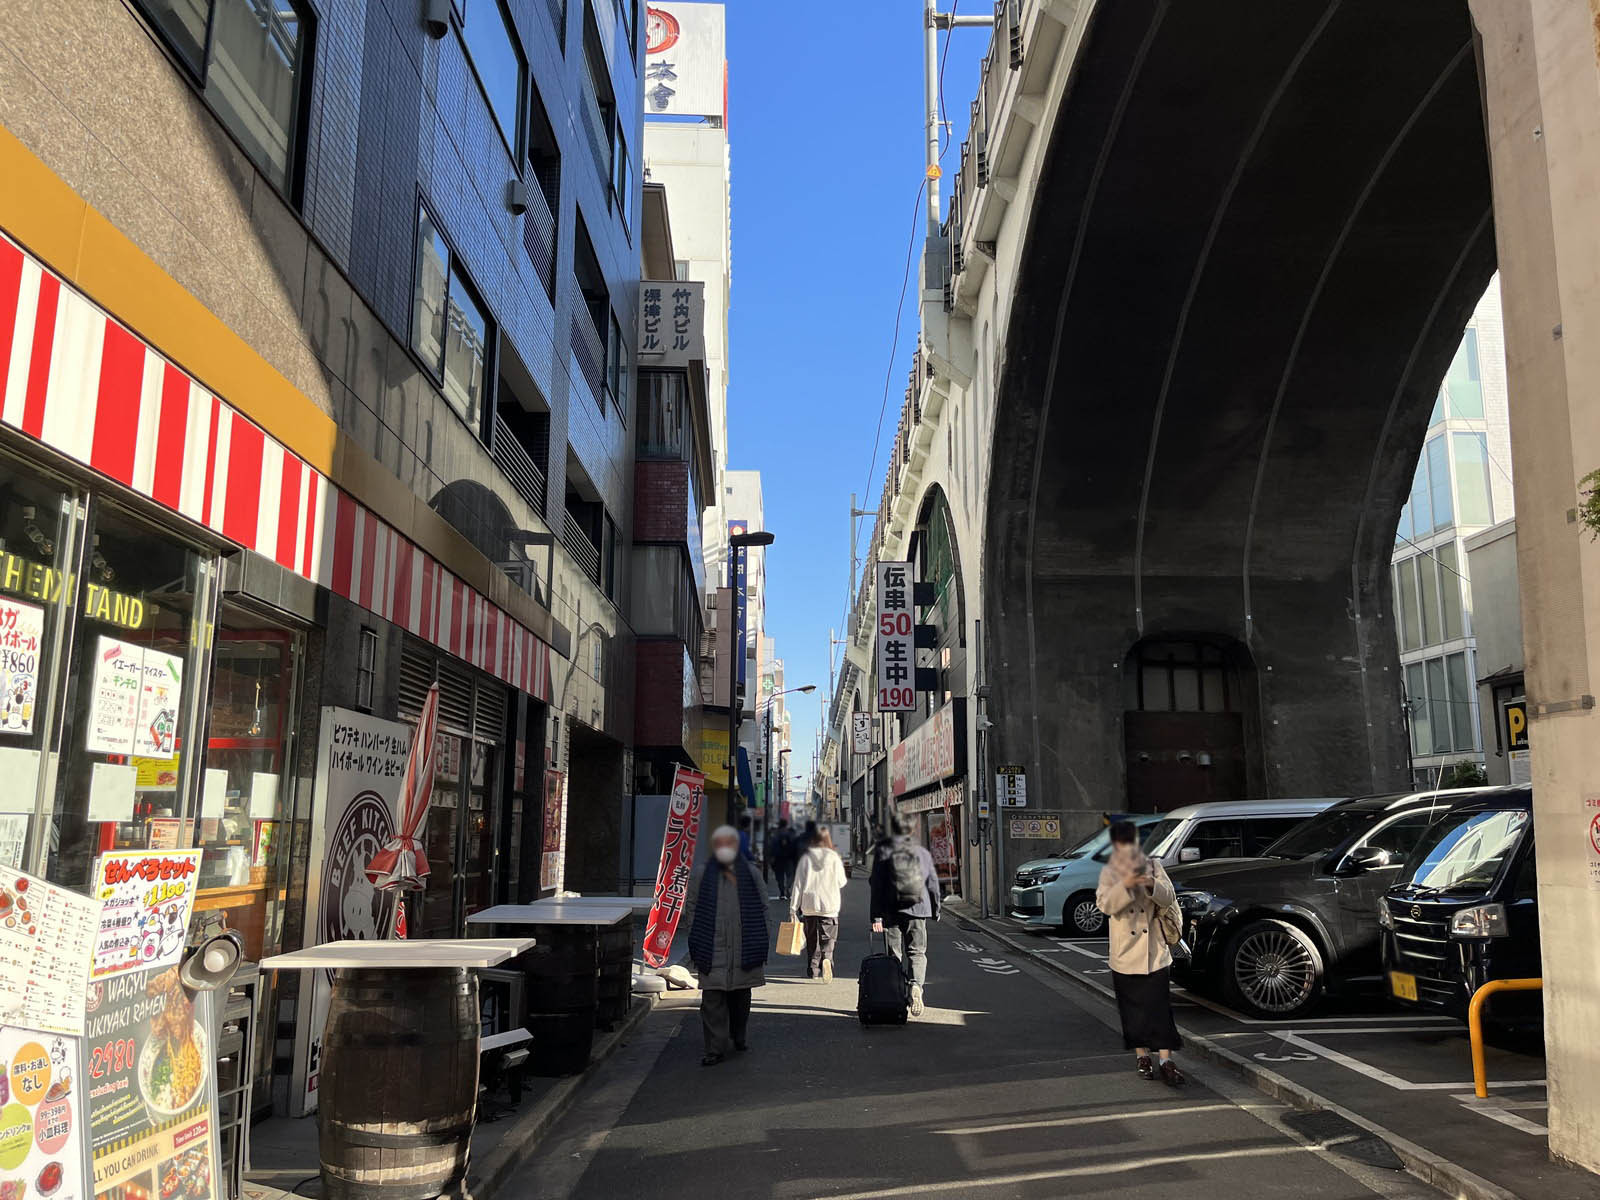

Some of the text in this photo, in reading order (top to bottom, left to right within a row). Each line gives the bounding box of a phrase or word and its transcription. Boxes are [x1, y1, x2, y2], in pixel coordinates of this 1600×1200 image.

[672, 288, 692, 351] 竹内ビル
[880, 566, 914, 708] 伝串 50 生中 190
[333, 723, 360, 747] ビフテキ
[361, 731, 391, 753] ハンバーグ
[332, 750, 364, 774] ハイボール
[366, 756, 384, 776] ワイン
[331, 817, 358, 888] BEEF
[105, 856, 196, 886] せんべろセット
[107, 970, 149, 1004] WAGYU
[87, 993, 167, 1039] UKIYAKI RAMEN
[22, 1074, 43, 1092] なし
[104, 1162, 121, 1178] YOU
[121, 1156, 136, 1172] CAN
[136, 1143, 159, 1163] DRINK
